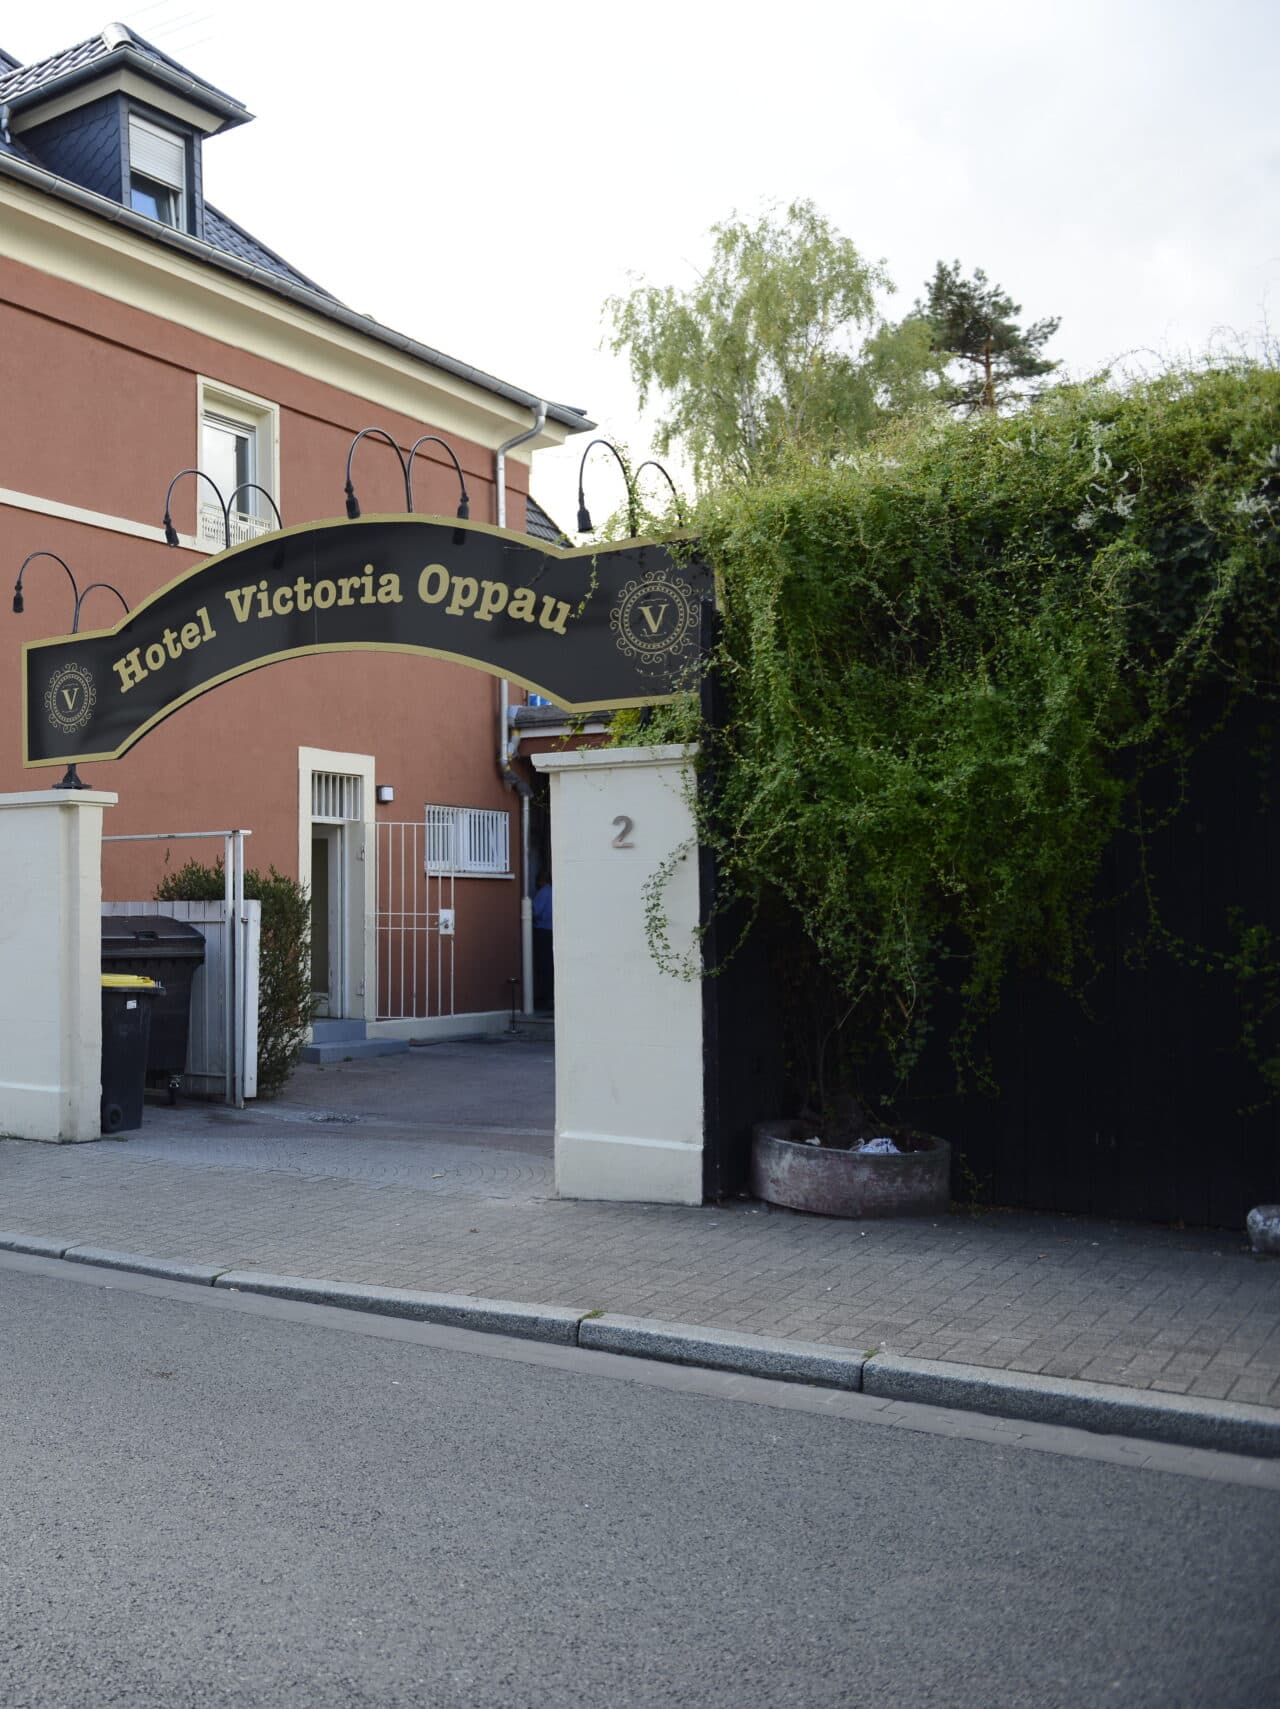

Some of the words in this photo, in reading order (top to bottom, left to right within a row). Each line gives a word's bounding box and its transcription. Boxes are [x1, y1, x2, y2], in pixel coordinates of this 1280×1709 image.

[113, 606, 217, 693] Hotel
[225, 564, 403, 623] Victoria
[418, 563, 571, 635] Oppau
[637, 603, 670, 634] V
[61, 687, 80, 711] V
[612, 815, 634, 849] 2
